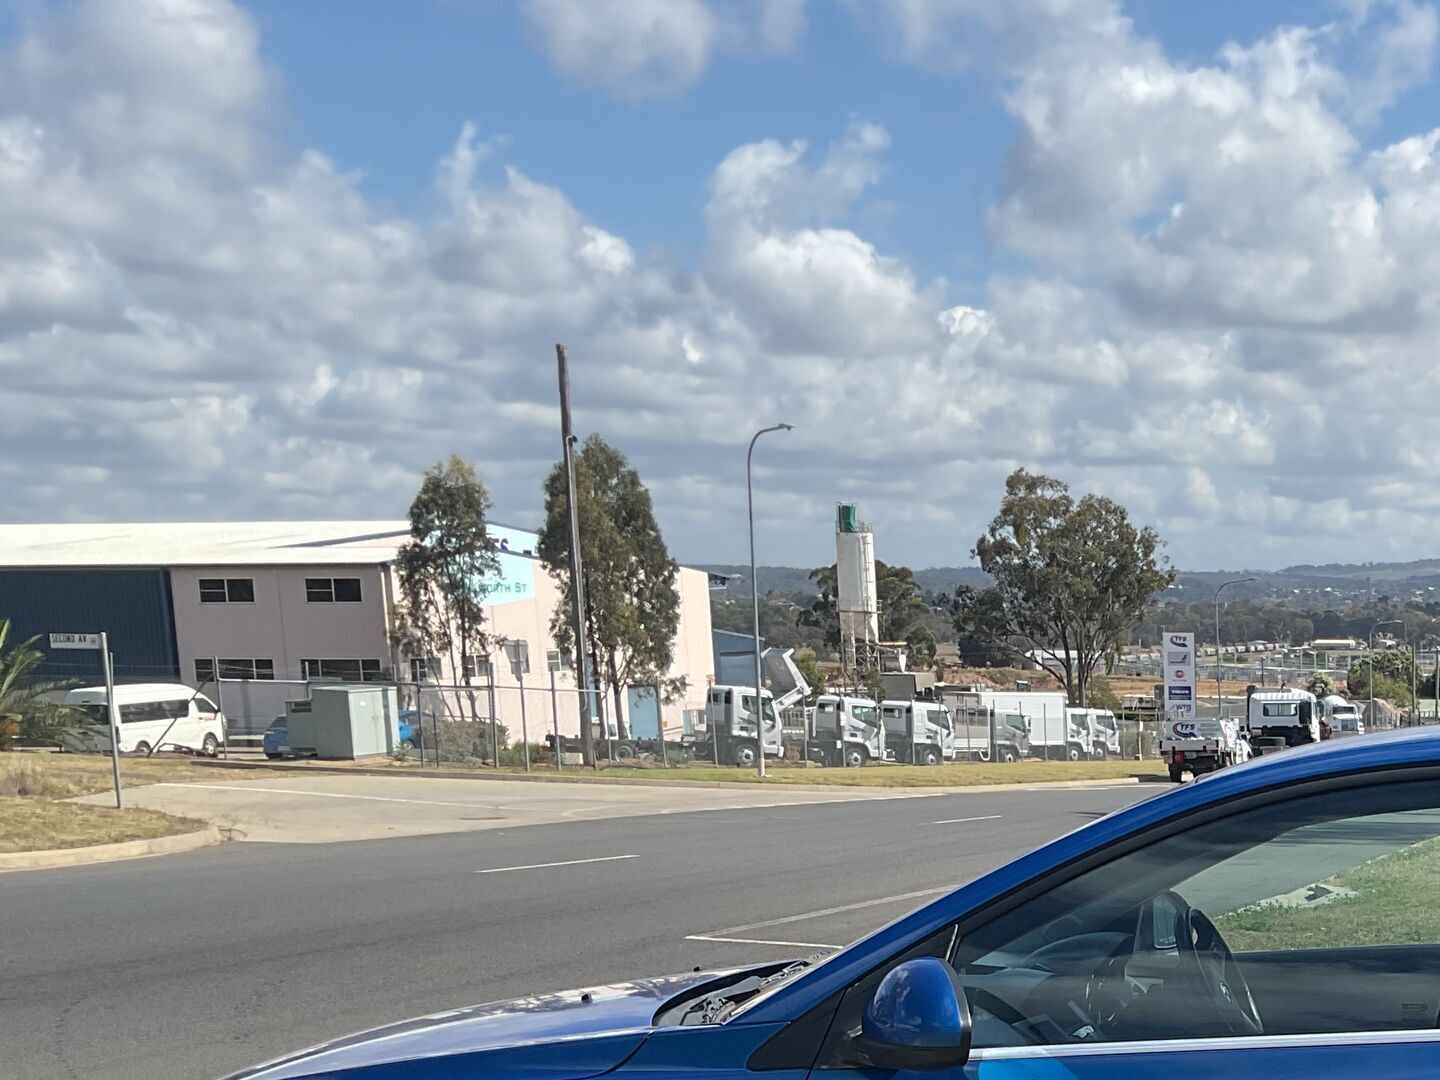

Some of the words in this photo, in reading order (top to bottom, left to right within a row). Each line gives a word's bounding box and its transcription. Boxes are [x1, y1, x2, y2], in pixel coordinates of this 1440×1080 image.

[51, 634, 75, 643] SECOND
[78, 634, 87, 643] AV
[1180, 723, 1195, 731] TFS
